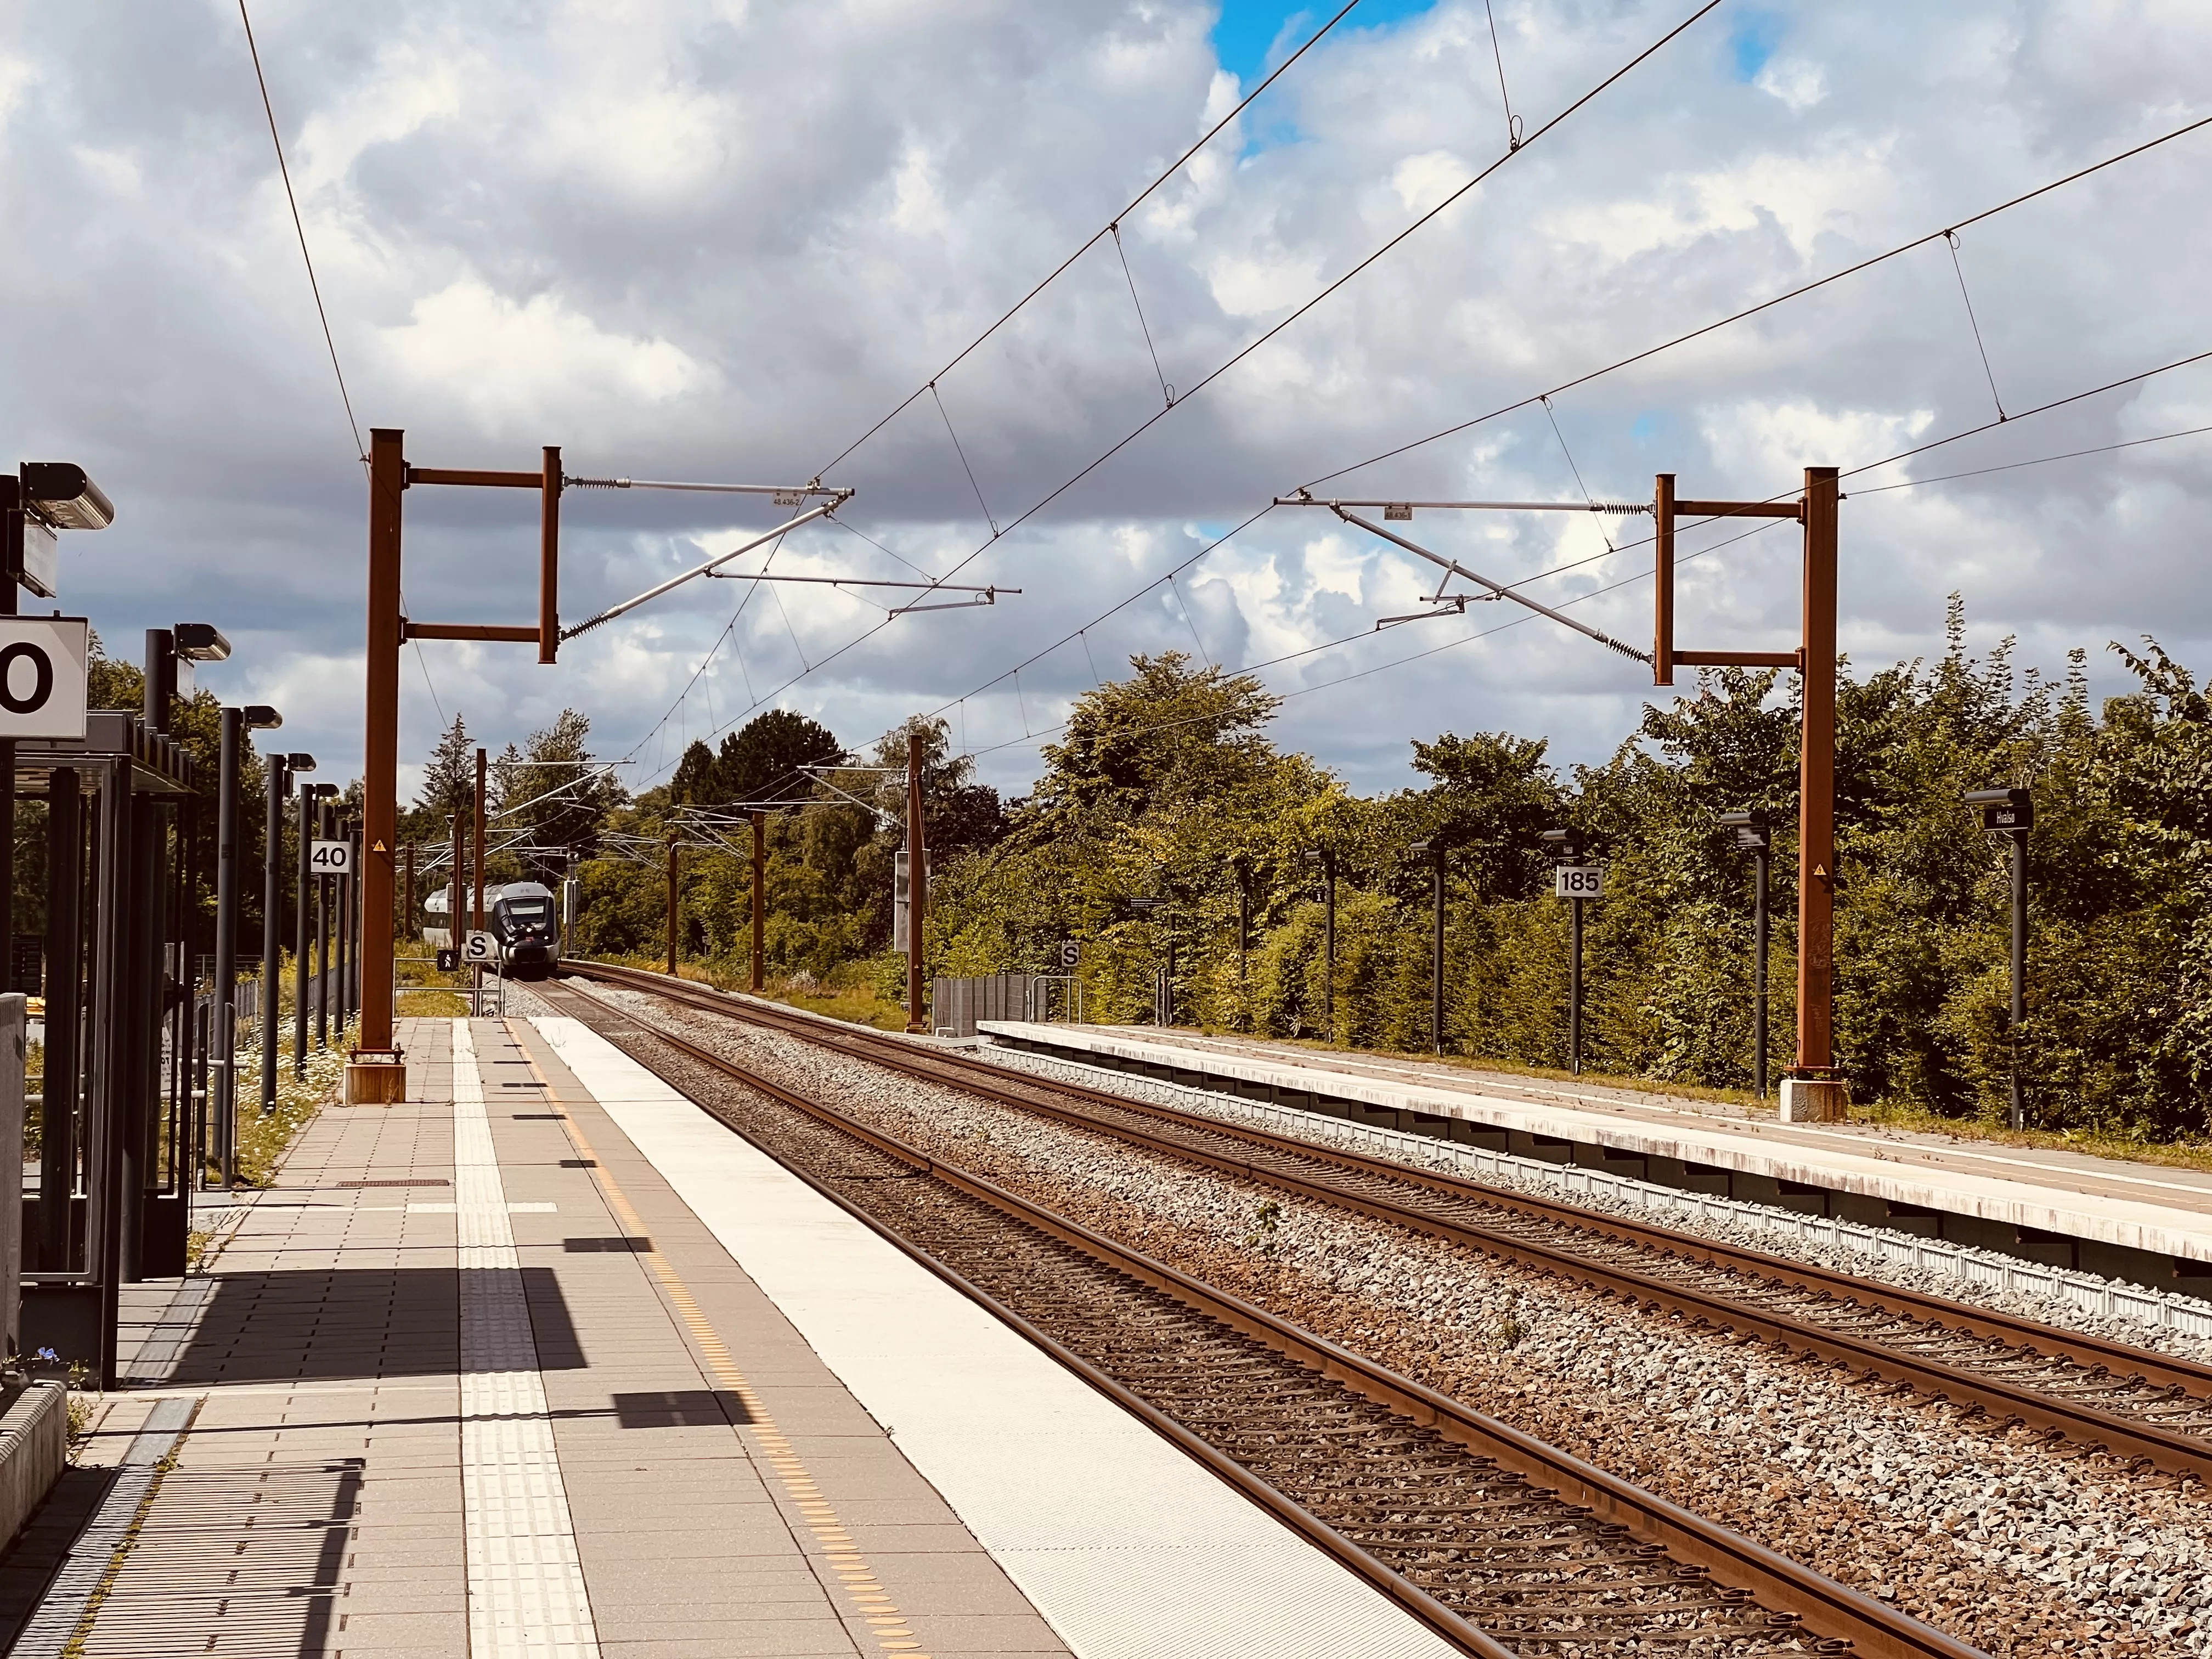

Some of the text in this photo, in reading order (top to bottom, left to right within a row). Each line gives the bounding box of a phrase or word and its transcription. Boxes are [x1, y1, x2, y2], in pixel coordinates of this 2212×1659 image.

[312, 847, 346, 867] 40
[1561, 872, 1599, 891] 185
[1316, 893, 1322, 901] 1
[470, 936, 486, 956] S
[1063, 946, 1078, 965] S
